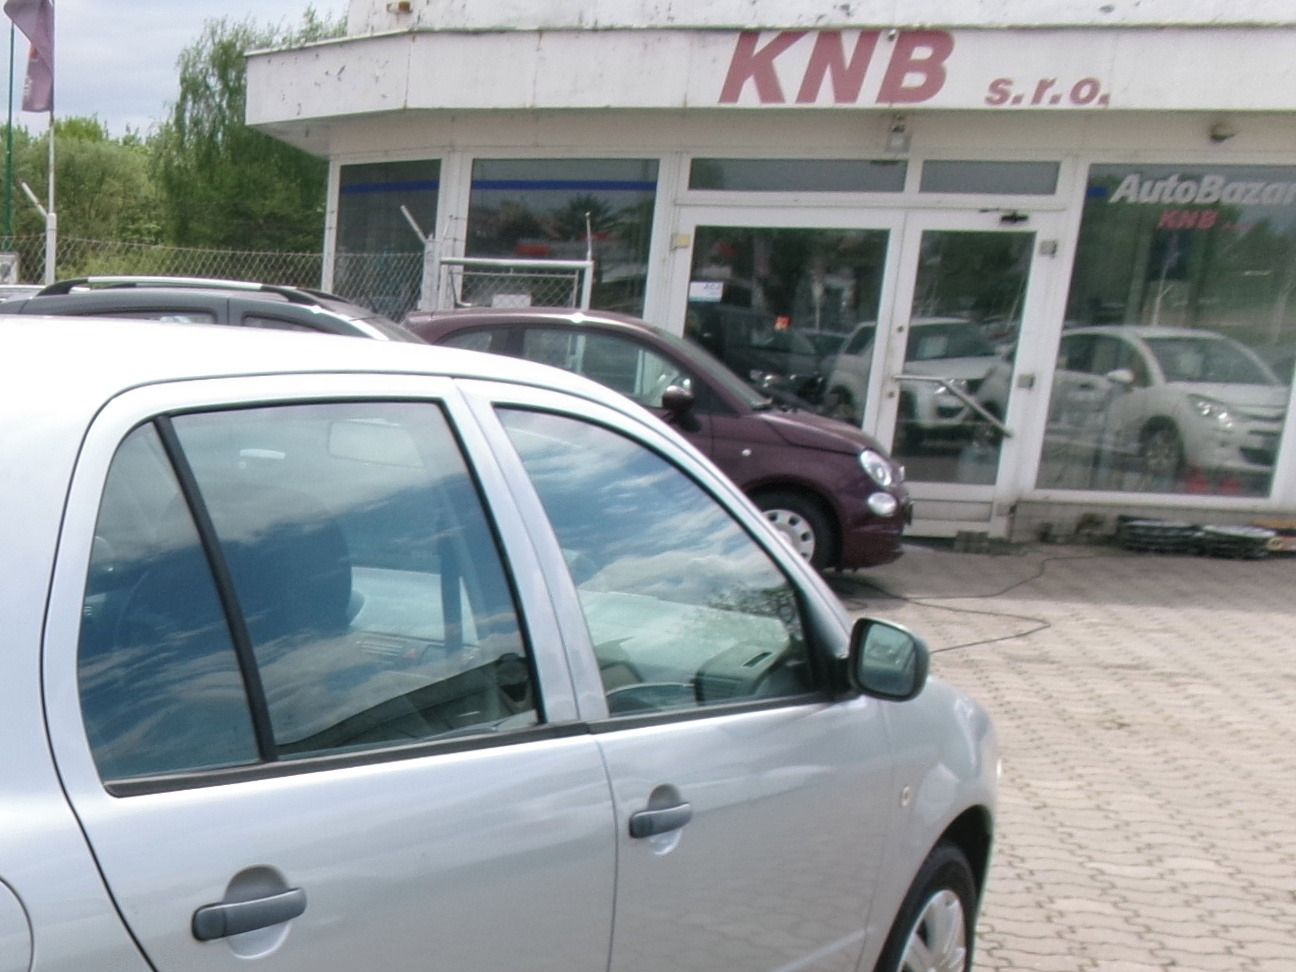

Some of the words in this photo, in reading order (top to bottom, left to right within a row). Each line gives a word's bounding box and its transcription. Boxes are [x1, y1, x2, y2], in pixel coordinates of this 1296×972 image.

[718, 28, 955, 105] KNB
[984, 77, 1112, 109] s.r.o.
[1157, 209, 1221, 231] KNB
